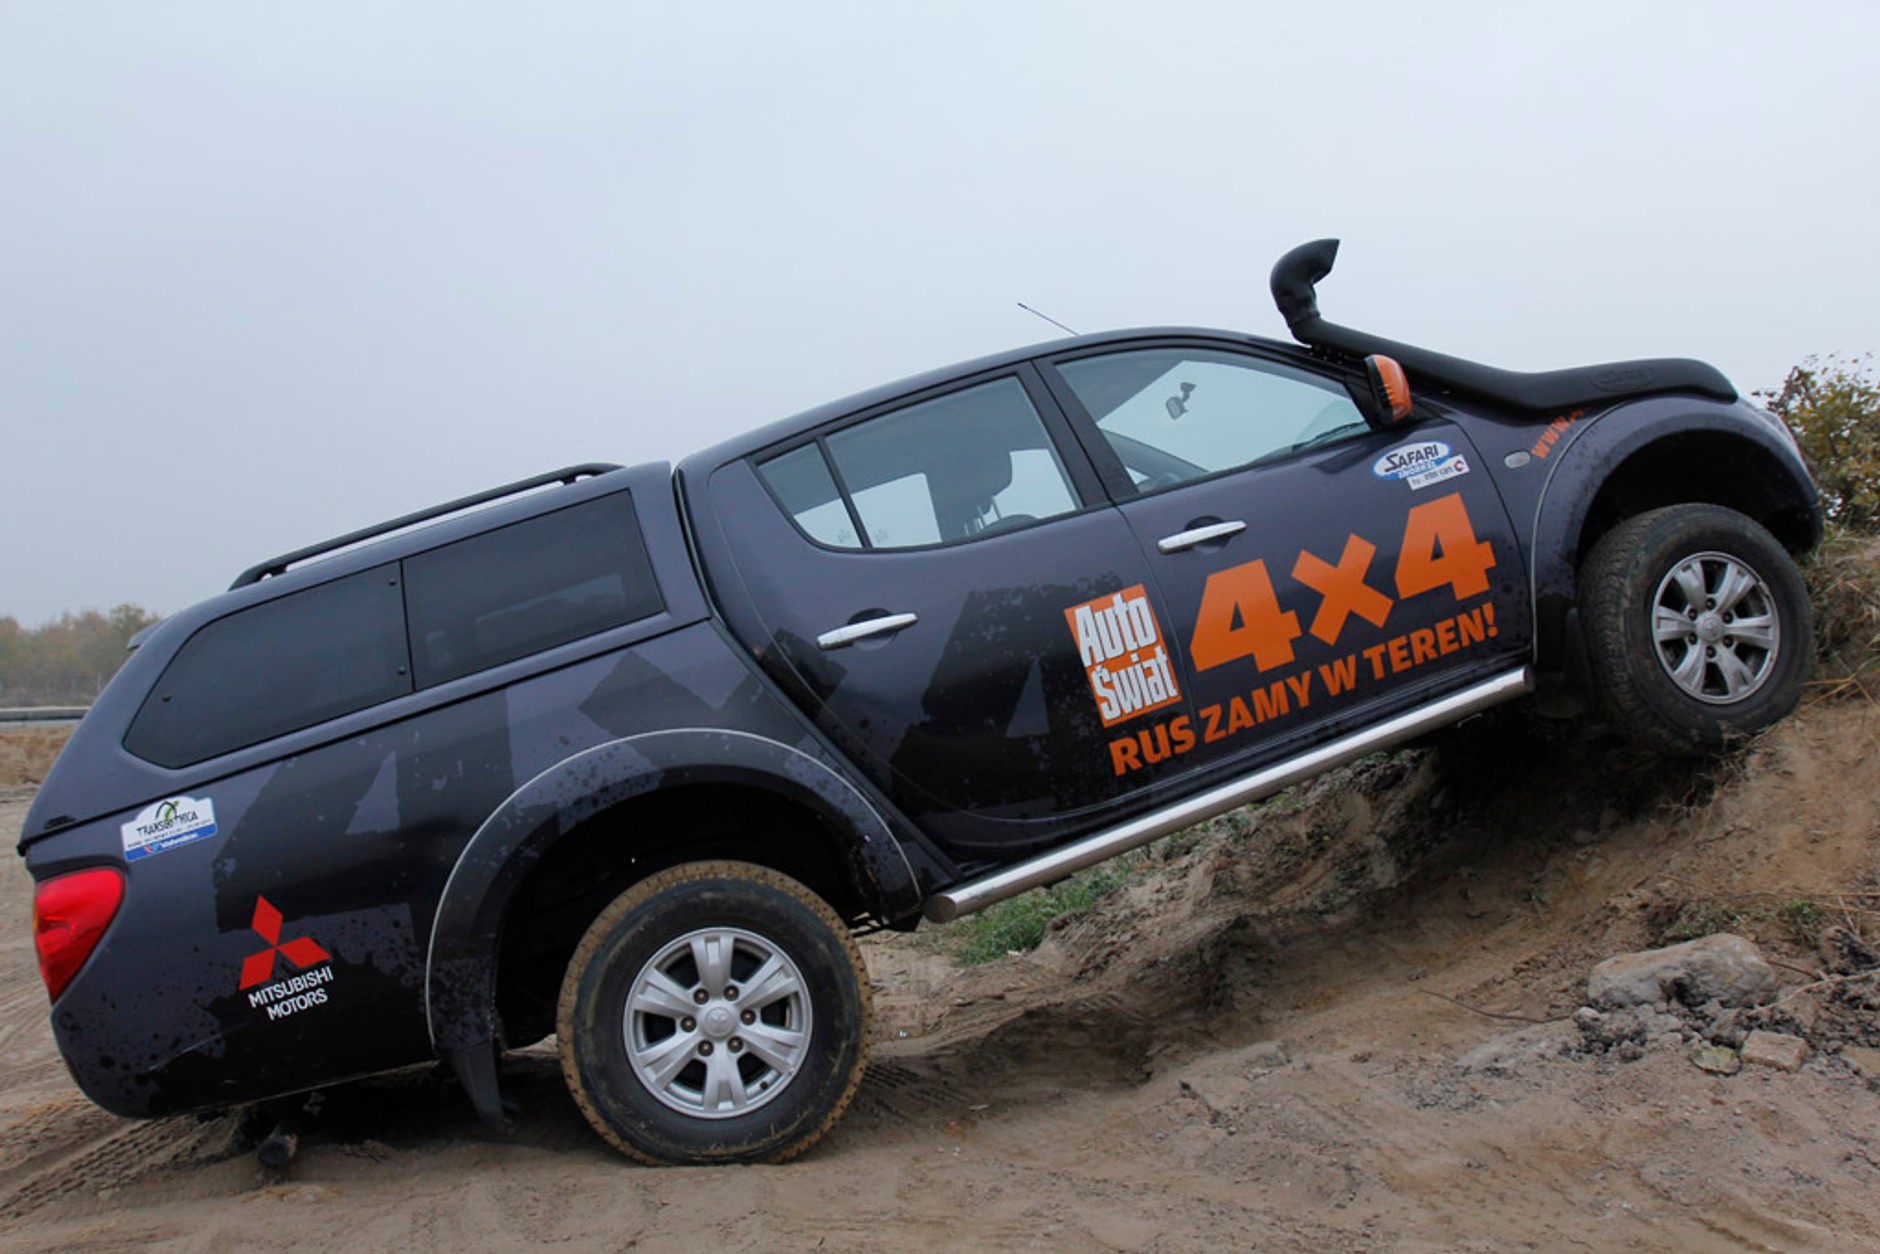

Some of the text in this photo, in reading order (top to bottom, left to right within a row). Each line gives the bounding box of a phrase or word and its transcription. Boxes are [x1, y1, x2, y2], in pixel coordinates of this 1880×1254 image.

[1384, 444, 1439, 473] SAFARI
[1075, 593, 1157, 667] Auto
[1318, 654, 1357, 696] W
[1363, 602, 1498, 680] TEREN!
[248, 966, 334, 1008] MITSUBISHI
[266, 988, 328, 1020] MOTORS
